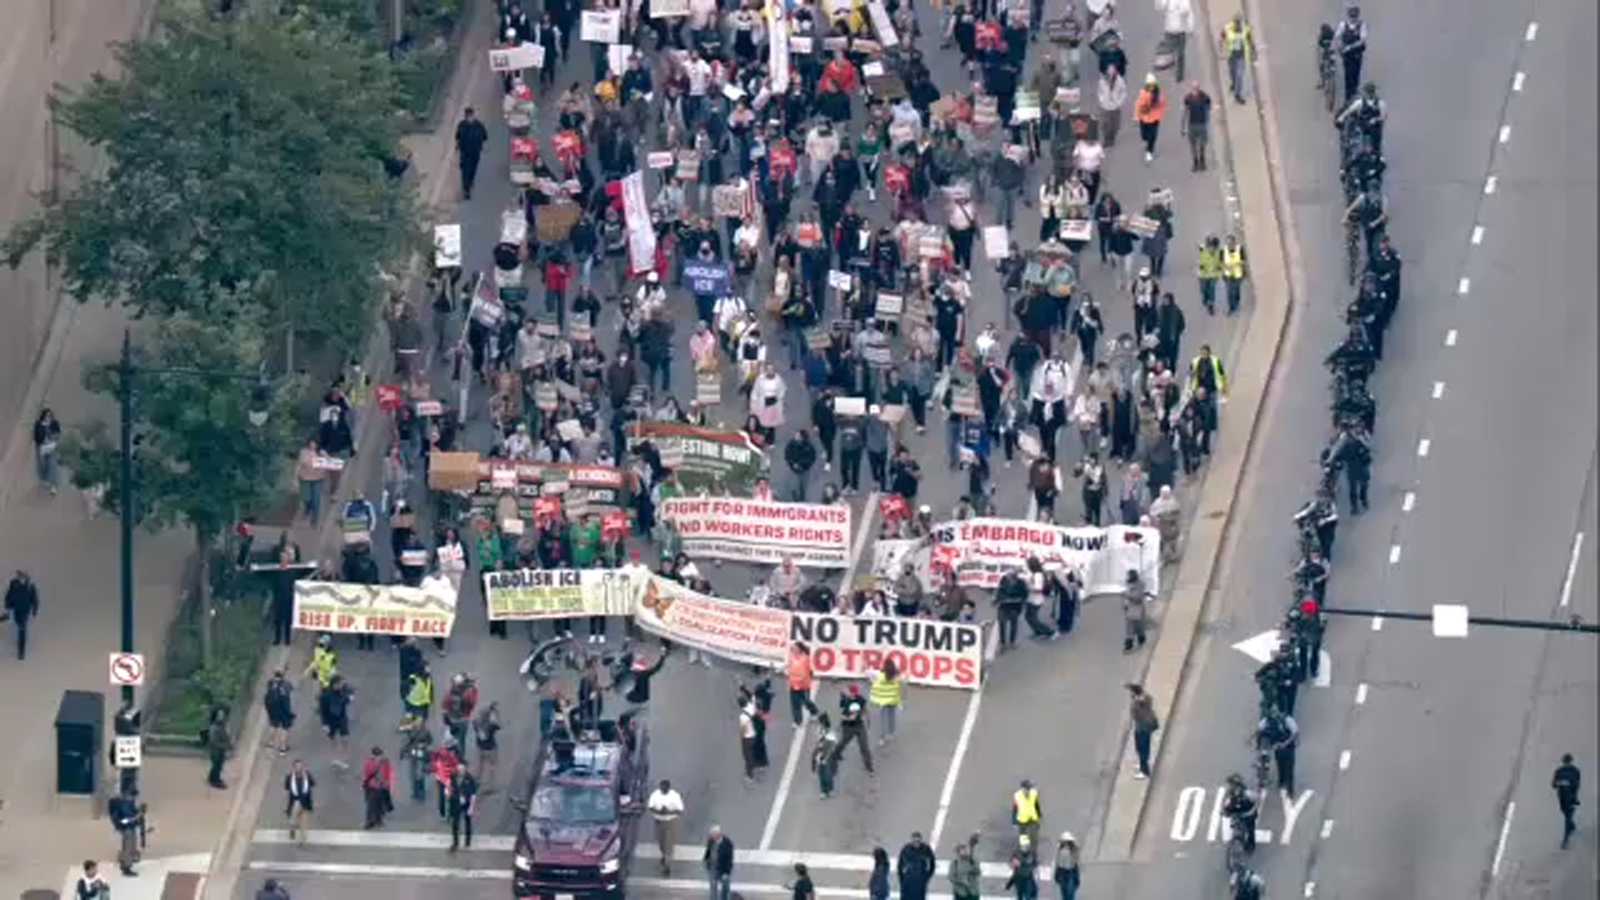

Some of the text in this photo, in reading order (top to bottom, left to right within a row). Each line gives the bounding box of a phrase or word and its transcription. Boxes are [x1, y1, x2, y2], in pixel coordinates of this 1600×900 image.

[664, 502, 847, 523] FIGHT FOR IMMIGRANTS
[679, 520, 843, 543] ND WORKERS RIGHTS
[961, 524, 1056, 546] EMBARGO
[1061, 532, 1109, 551] NOW!
[490, 571, 582, 589] ABOLISH ICE
[300, 612, 331, 628] RISE
[366, 617, 406, 632] FIGHT
[413, 619, 447, 634] BACK
[790, 615, 977, 653] NO TRUMP
